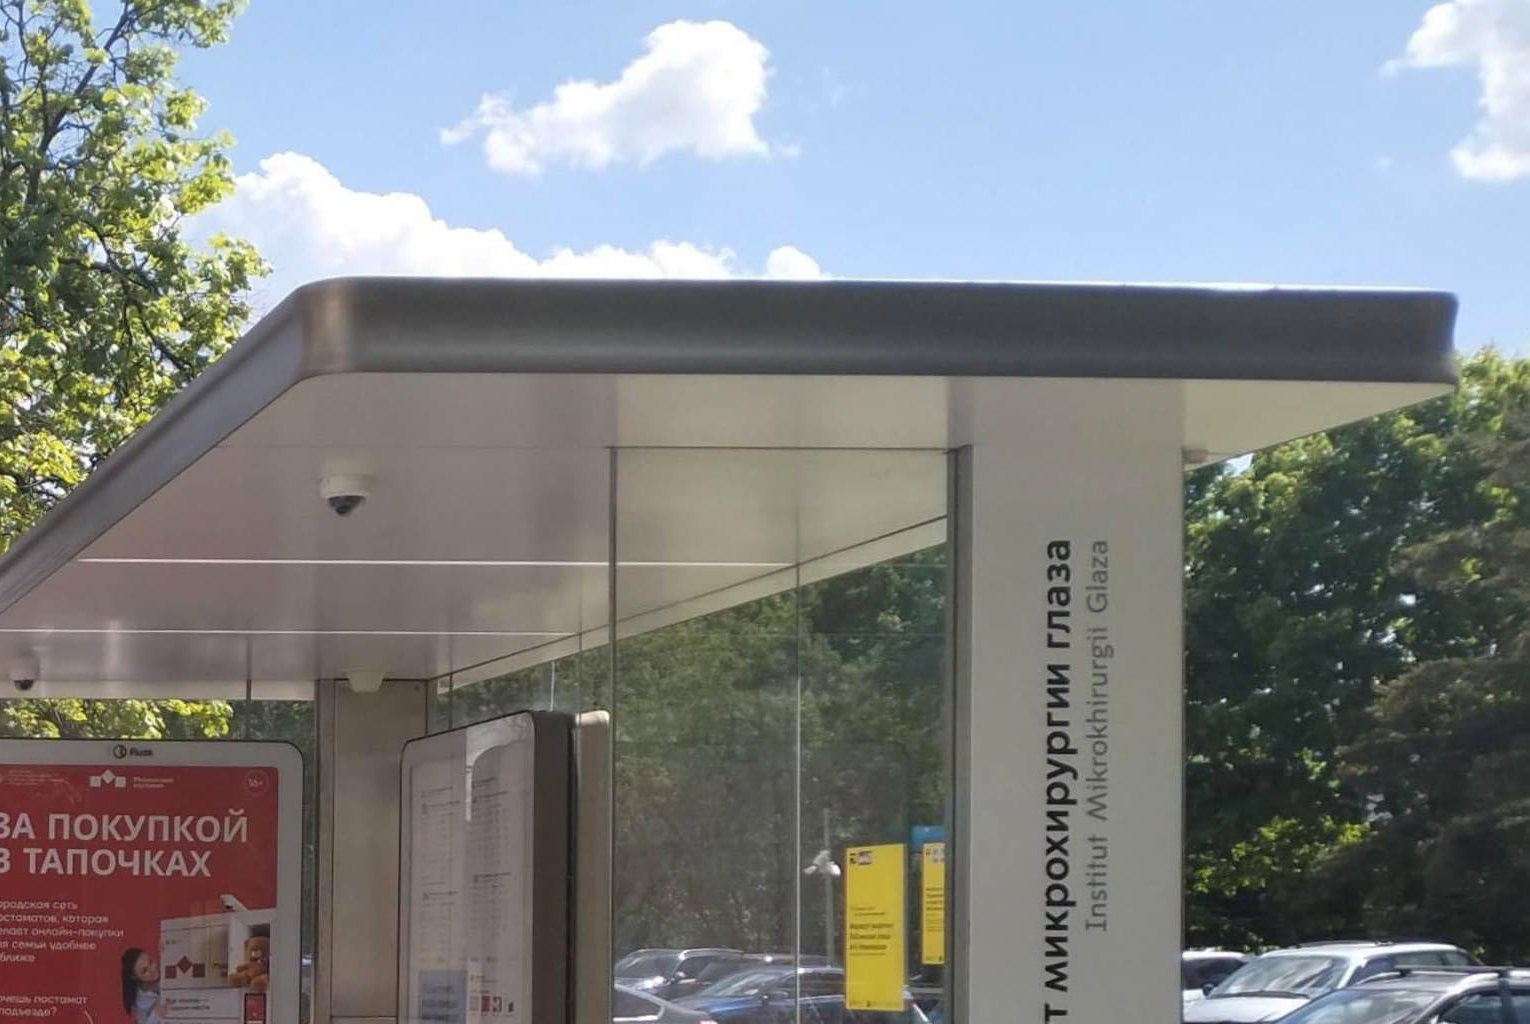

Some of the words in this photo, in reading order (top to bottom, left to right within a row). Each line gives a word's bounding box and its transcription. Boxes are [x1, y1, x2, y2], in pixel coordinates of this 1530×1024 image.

[1085, 540, 1109, 613] Glaza
[1046, 540, 1071, 649] глаза
[1085, 627, 1114, 821] Mikrokhirurgii
[48, 808, 248, 843] ПОКУПКОЙ
[1044, 664, 1078, 992] микрохирургии
[23, 848, 211, 877] ТАПОЧКАХ
[1085, 835, 1107, 932] Institut
[52, 901, 78, 910] сеть
[62, 914, 109, 925] которая
[11, 940, 47, 949] семьи
[50, 940, 97, 952] удобнее
[31, 926, 124, 940] онлайн-покупки
[0, 952, 36, 963] ближе
